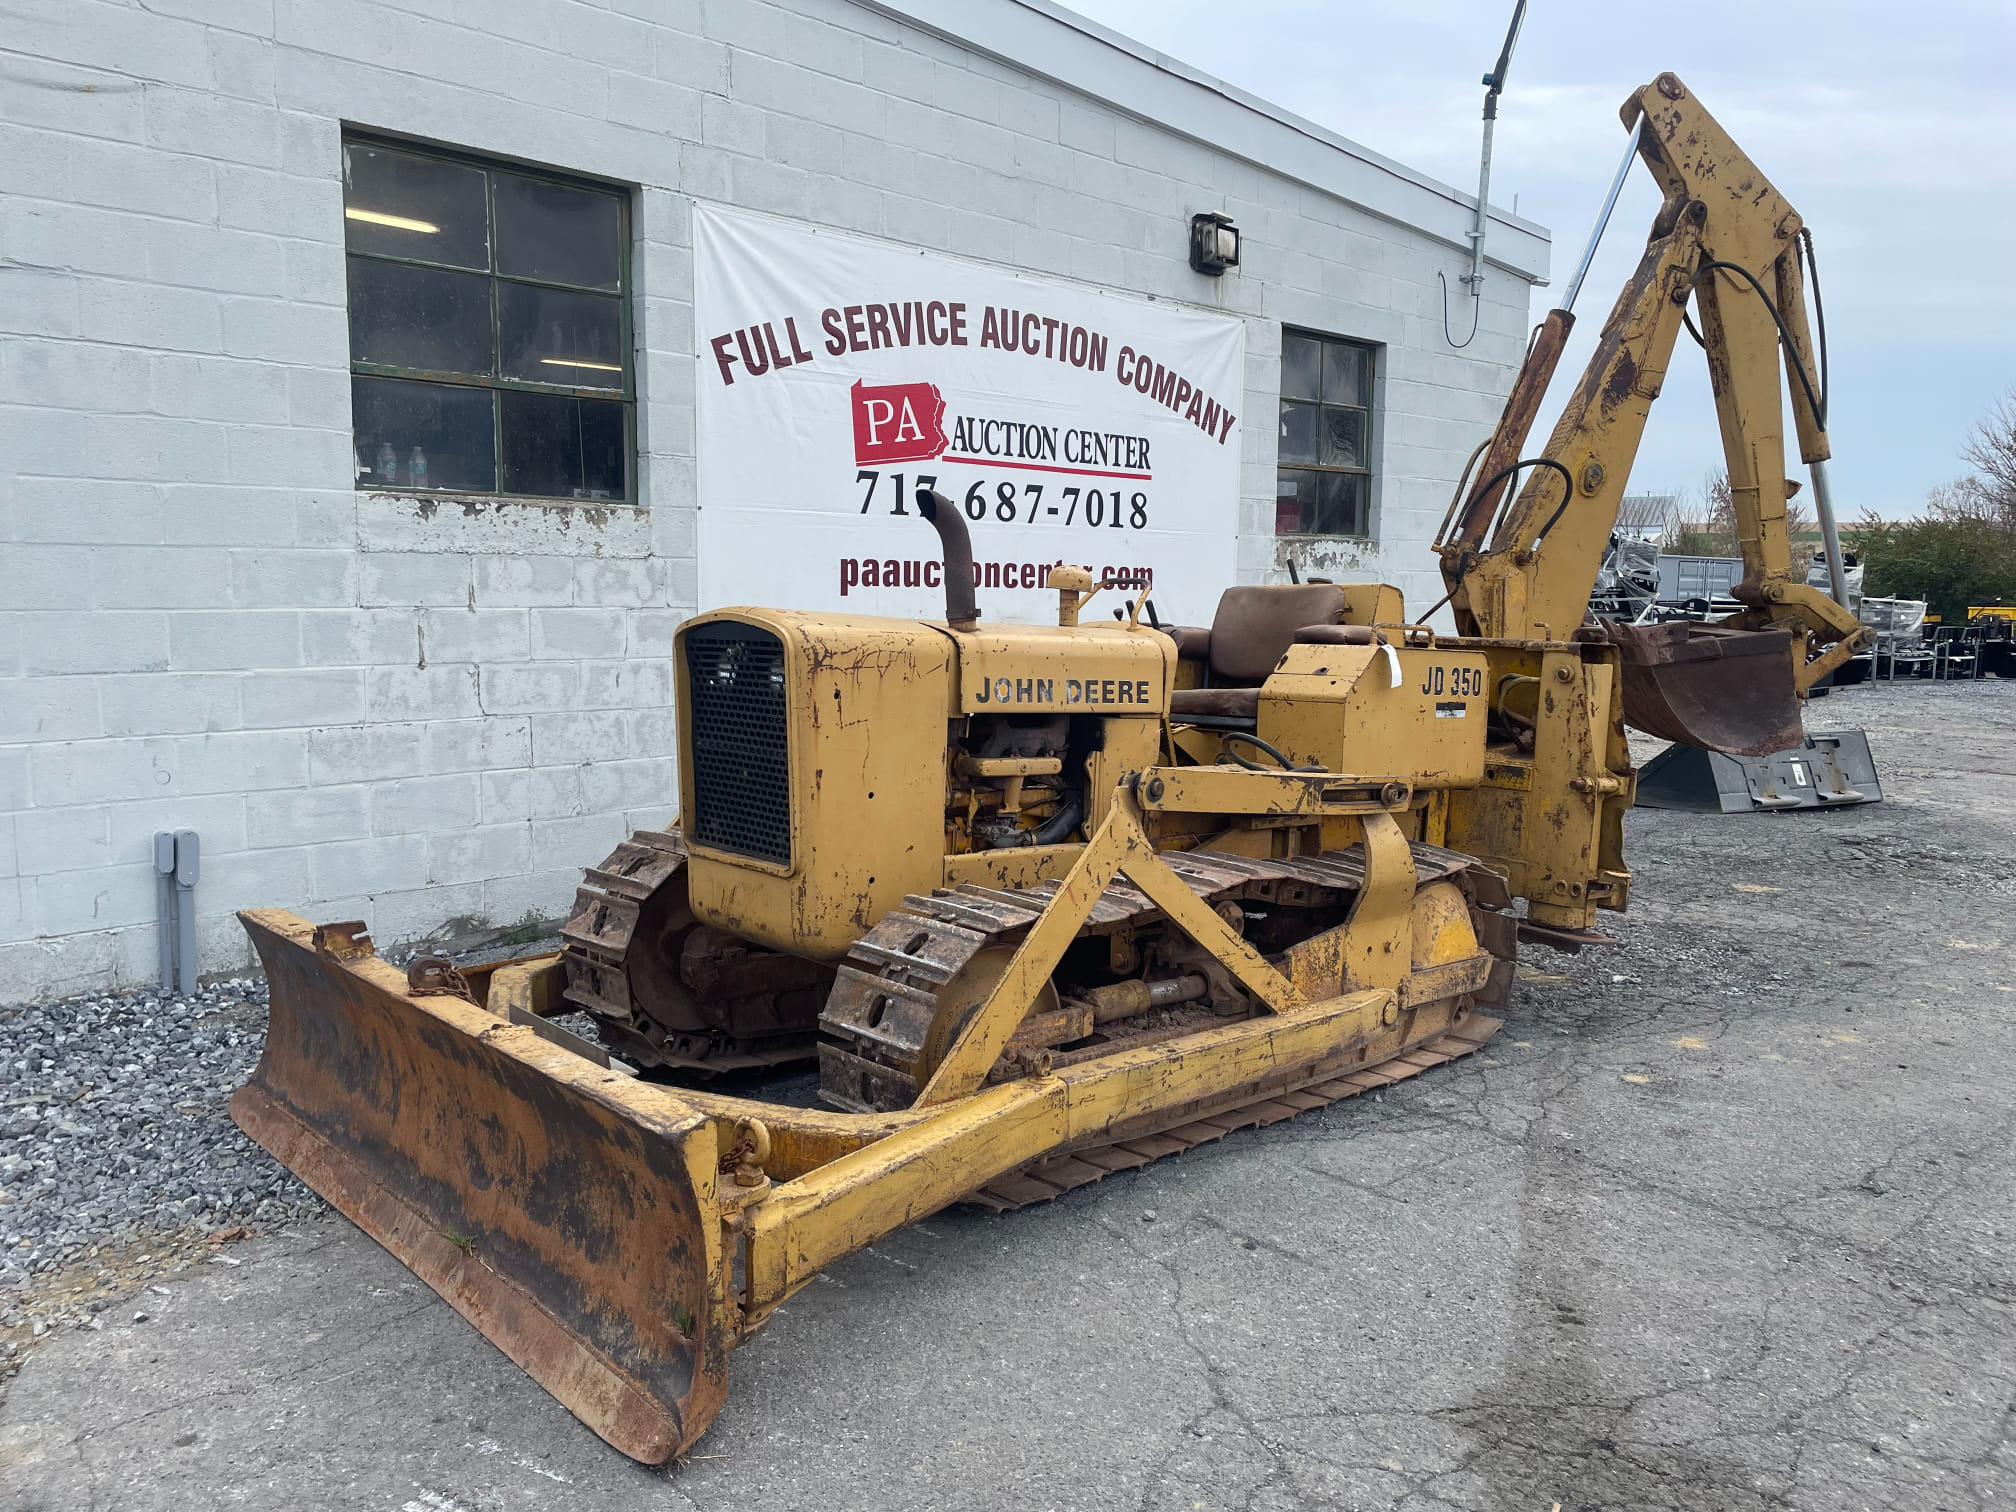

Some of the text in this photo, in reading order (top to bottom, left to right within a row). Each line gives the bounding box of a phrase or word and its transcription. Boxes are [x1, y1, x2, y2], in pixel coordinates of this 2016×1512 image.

[711, 301, 1236, 446] FULL SERVICE AUCTION COMPANY
[863, 396, 1151, 470] PA AUCTION CENTER
[856, 470, 1147, 529] 717687-7018
[840, 558, 1153, 596] paauconcen.com
[976, 677, 1149, 704] JOHN DEERE
[1422, 666, 1482, 697] JD 350
